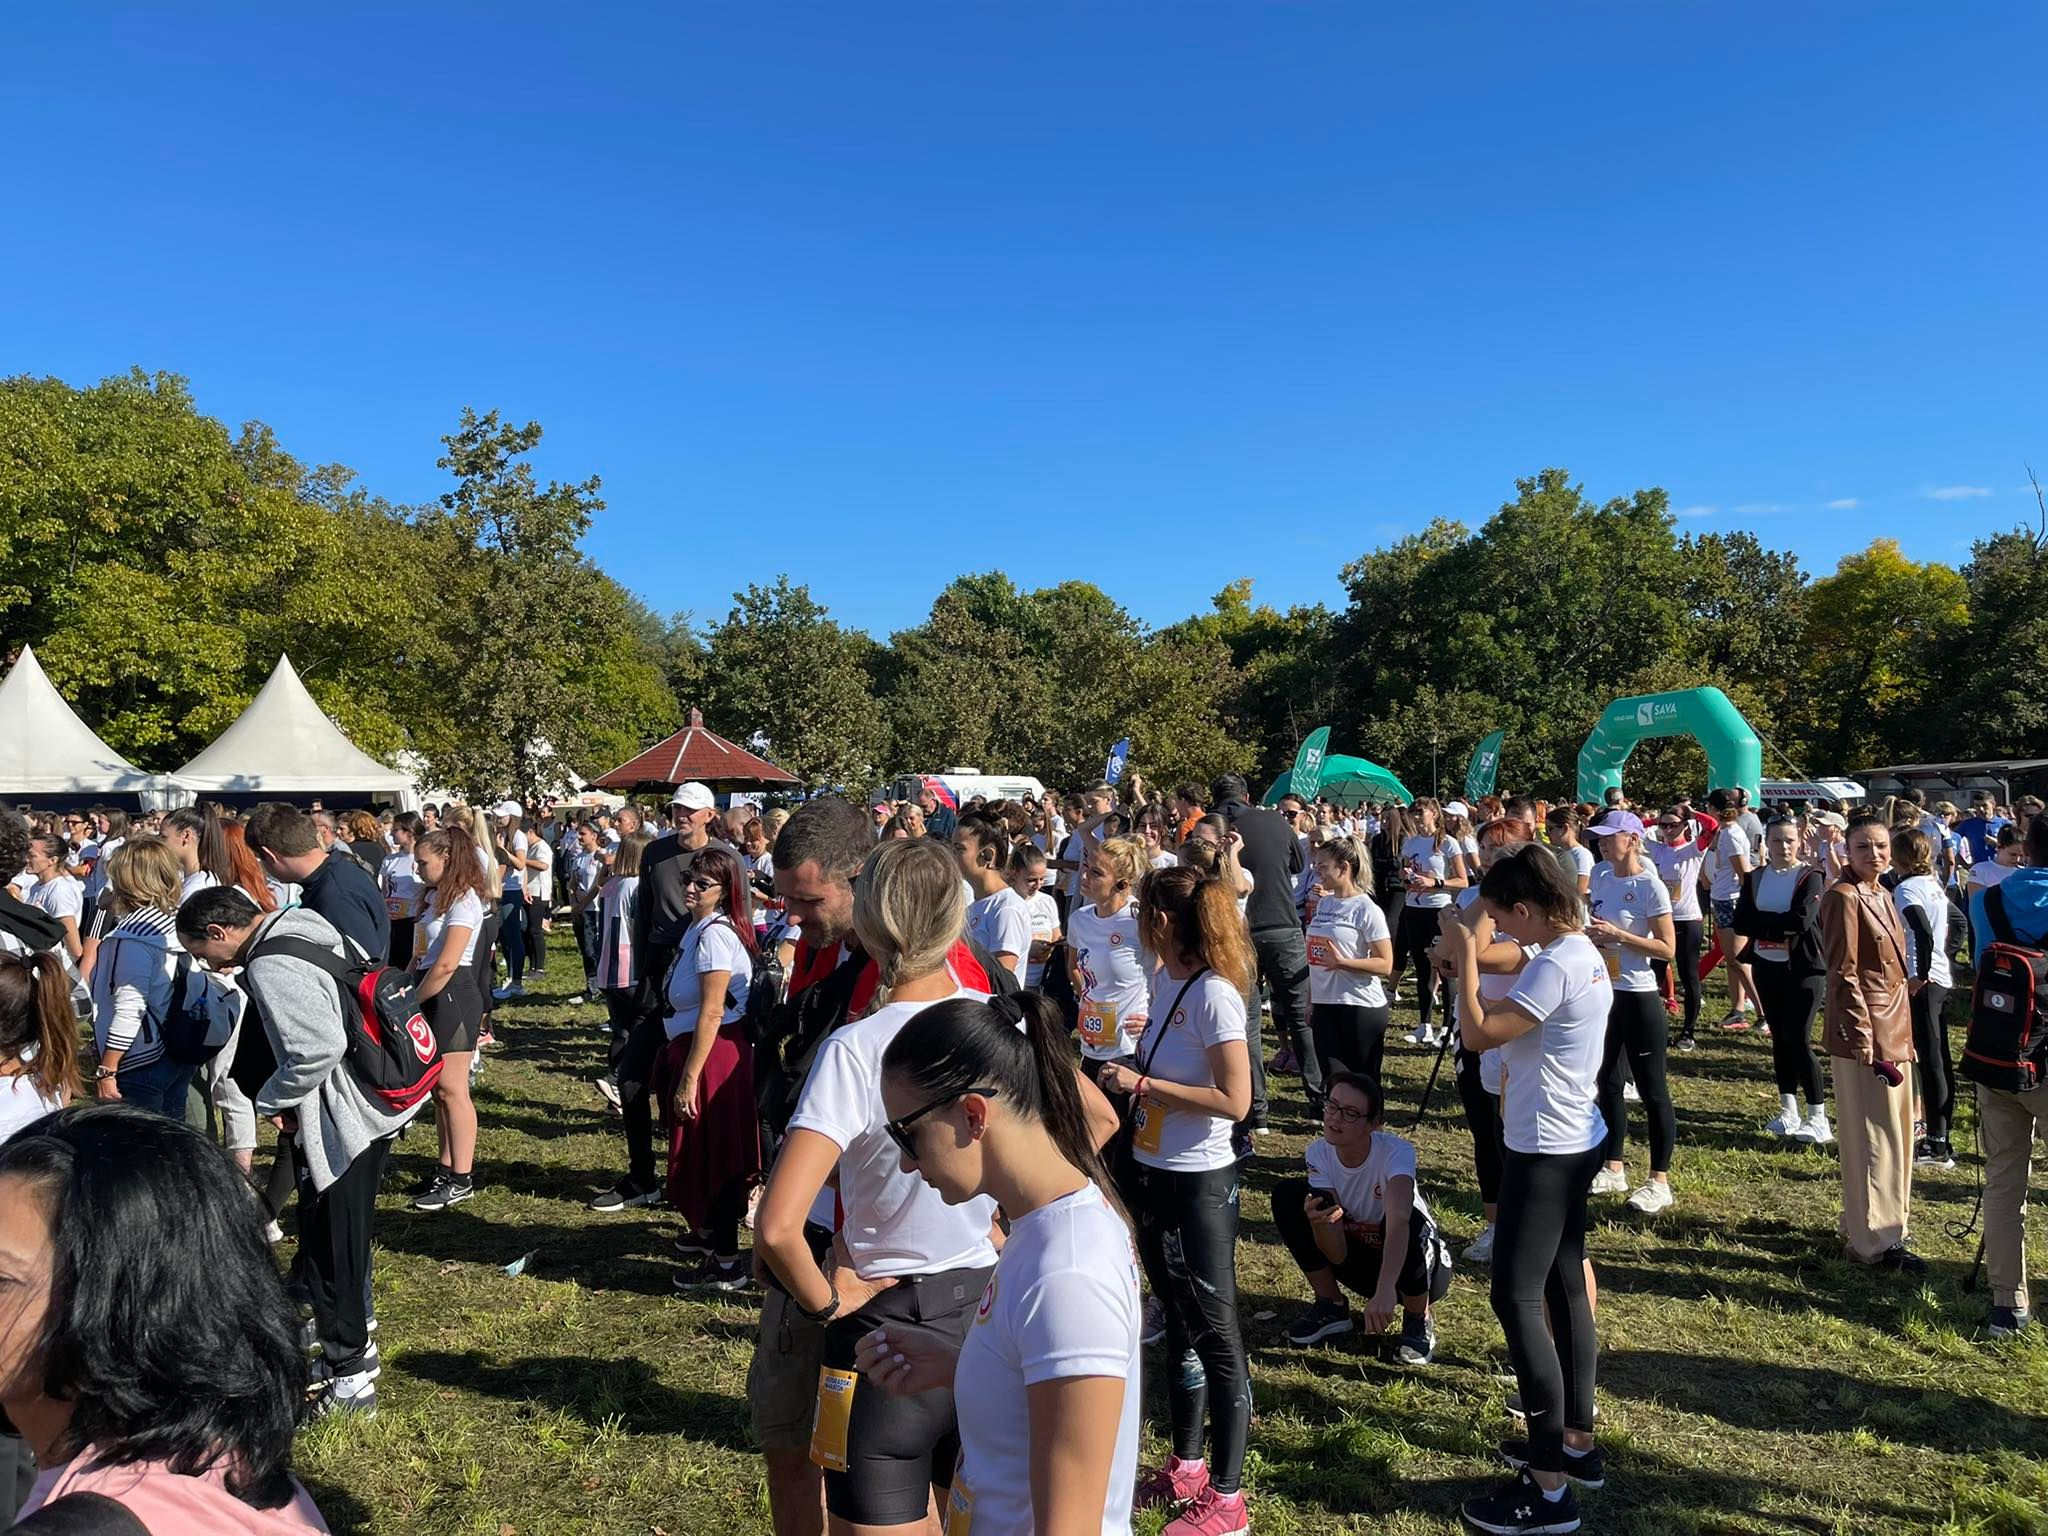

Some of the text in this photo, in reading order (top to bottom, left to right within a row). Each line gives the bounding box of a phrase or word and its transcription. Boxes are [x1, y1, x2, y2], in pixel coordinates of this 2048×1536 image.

[1654, 702, 1677, 716] SAVA
[1760, 788, 1820, 796] MBULANC
[1084, 1016, 1103, 1033] 439
